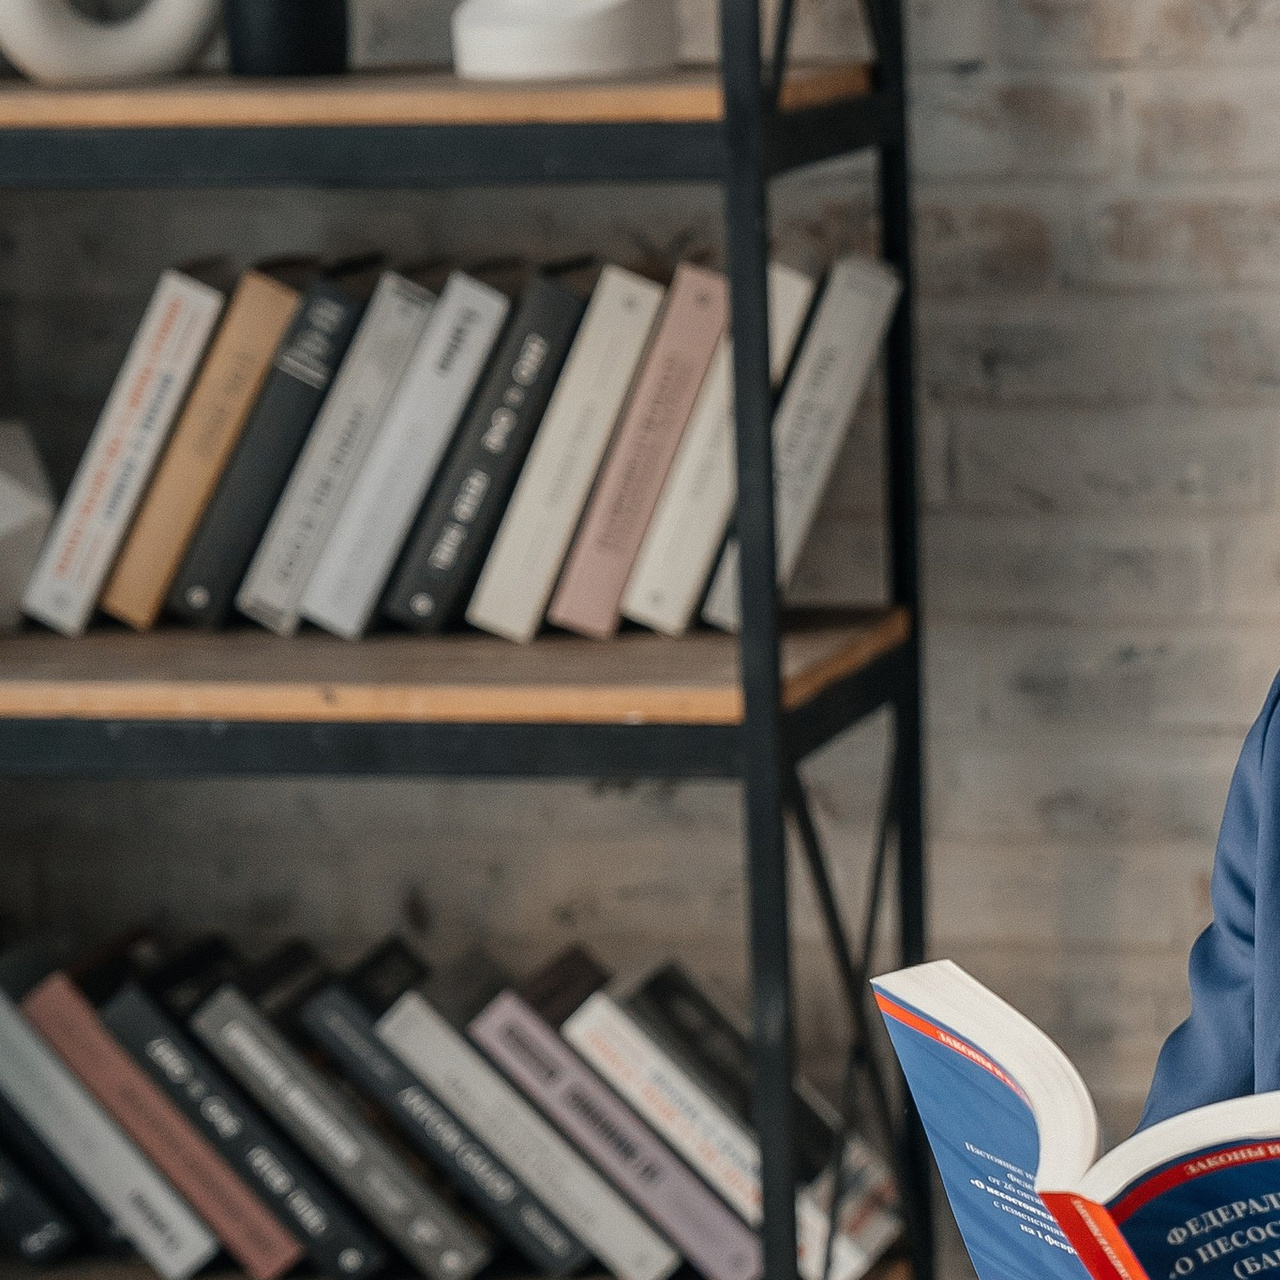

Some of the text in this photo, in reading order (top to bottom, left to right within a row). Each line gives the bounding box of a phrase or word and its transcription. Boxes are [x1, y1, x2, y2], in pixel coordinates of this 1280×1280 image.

[1184, 1143, 1265, 1175] ЗАКОНЫ
[986, 1185, 1056, 1223] несостоятел
[1016, 1189, 1044, 1206] октя
[1020, 1223, 1035, 1235] на
